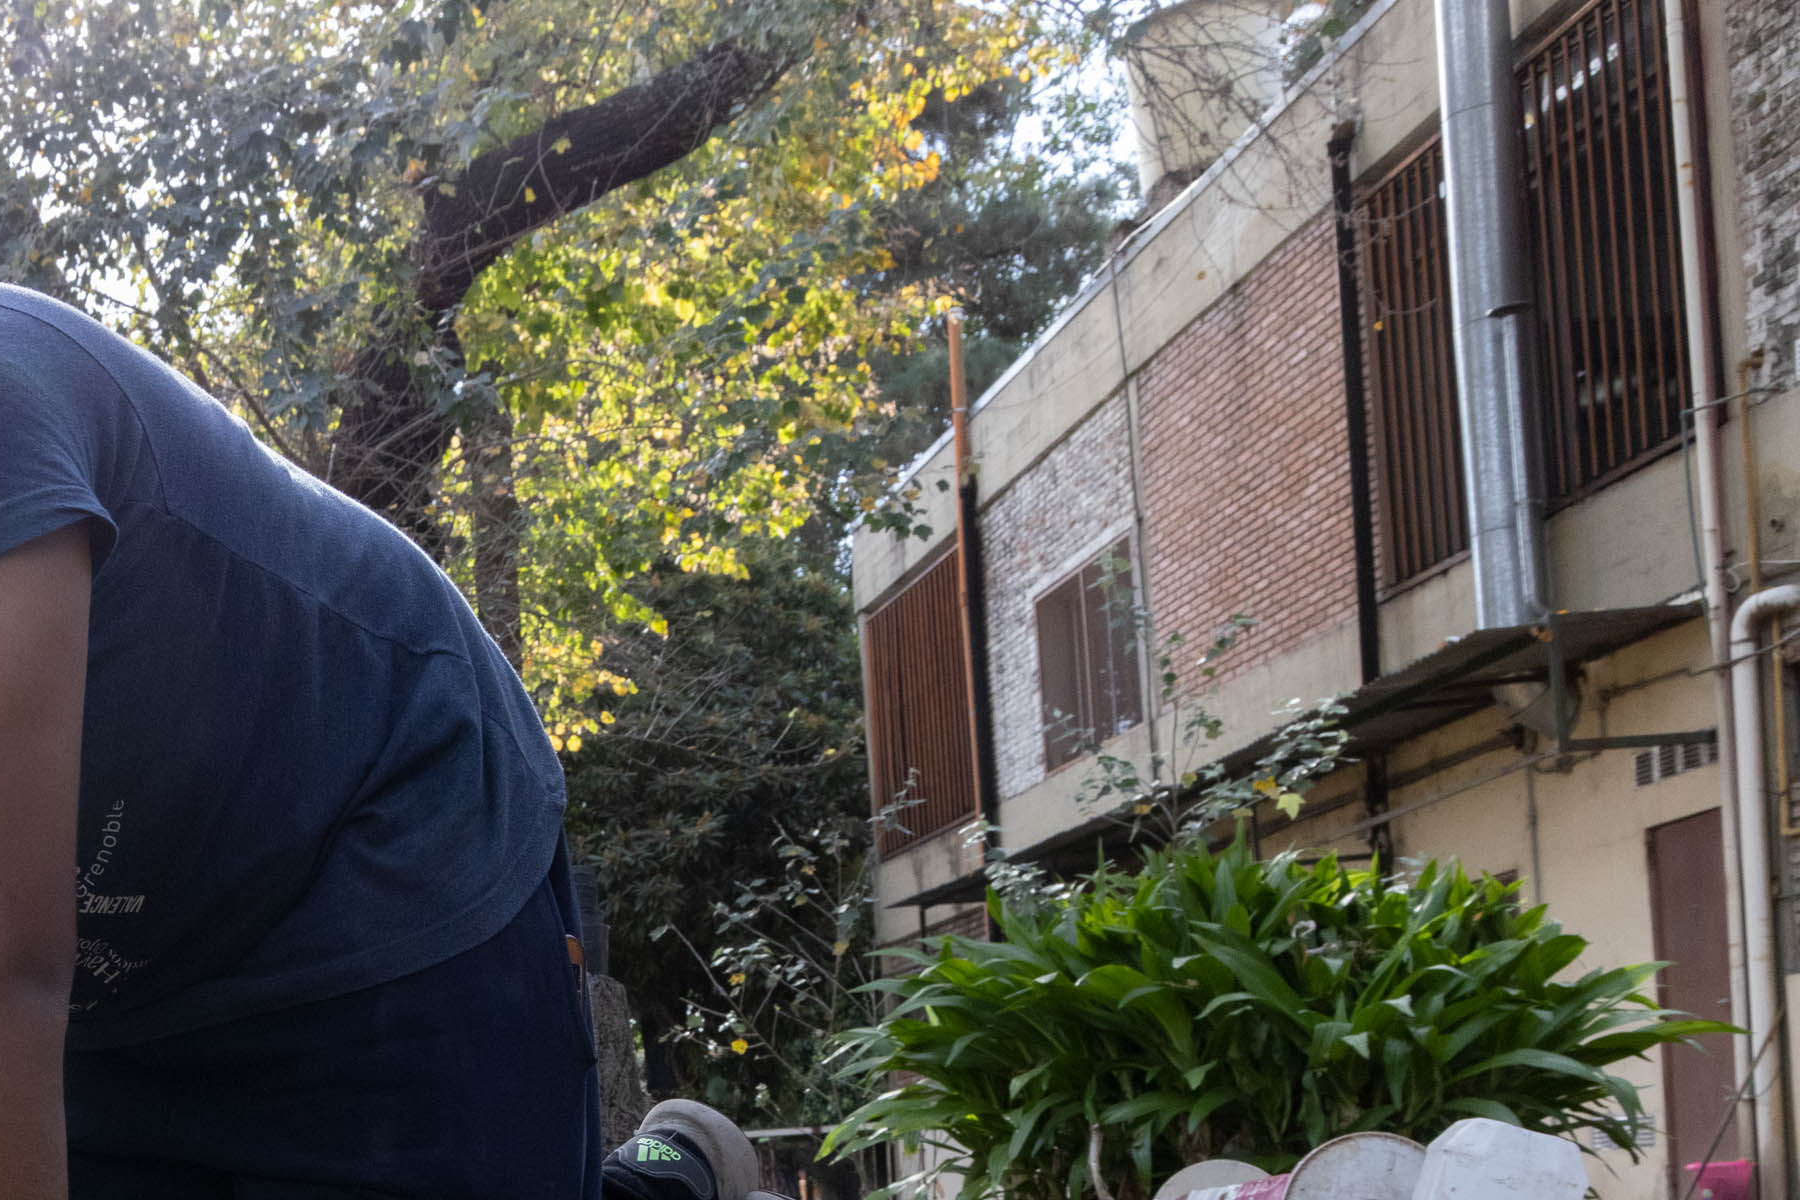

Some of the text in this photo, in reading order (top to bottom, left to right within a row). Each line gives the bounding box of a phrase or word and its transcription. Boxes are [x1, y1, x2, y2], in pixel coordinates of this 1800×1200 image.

[76, 798, 126, 898] Grenoble
[80, 893, 145, 914] VALENCE
[636, 1137, 682, 1161] adidas
